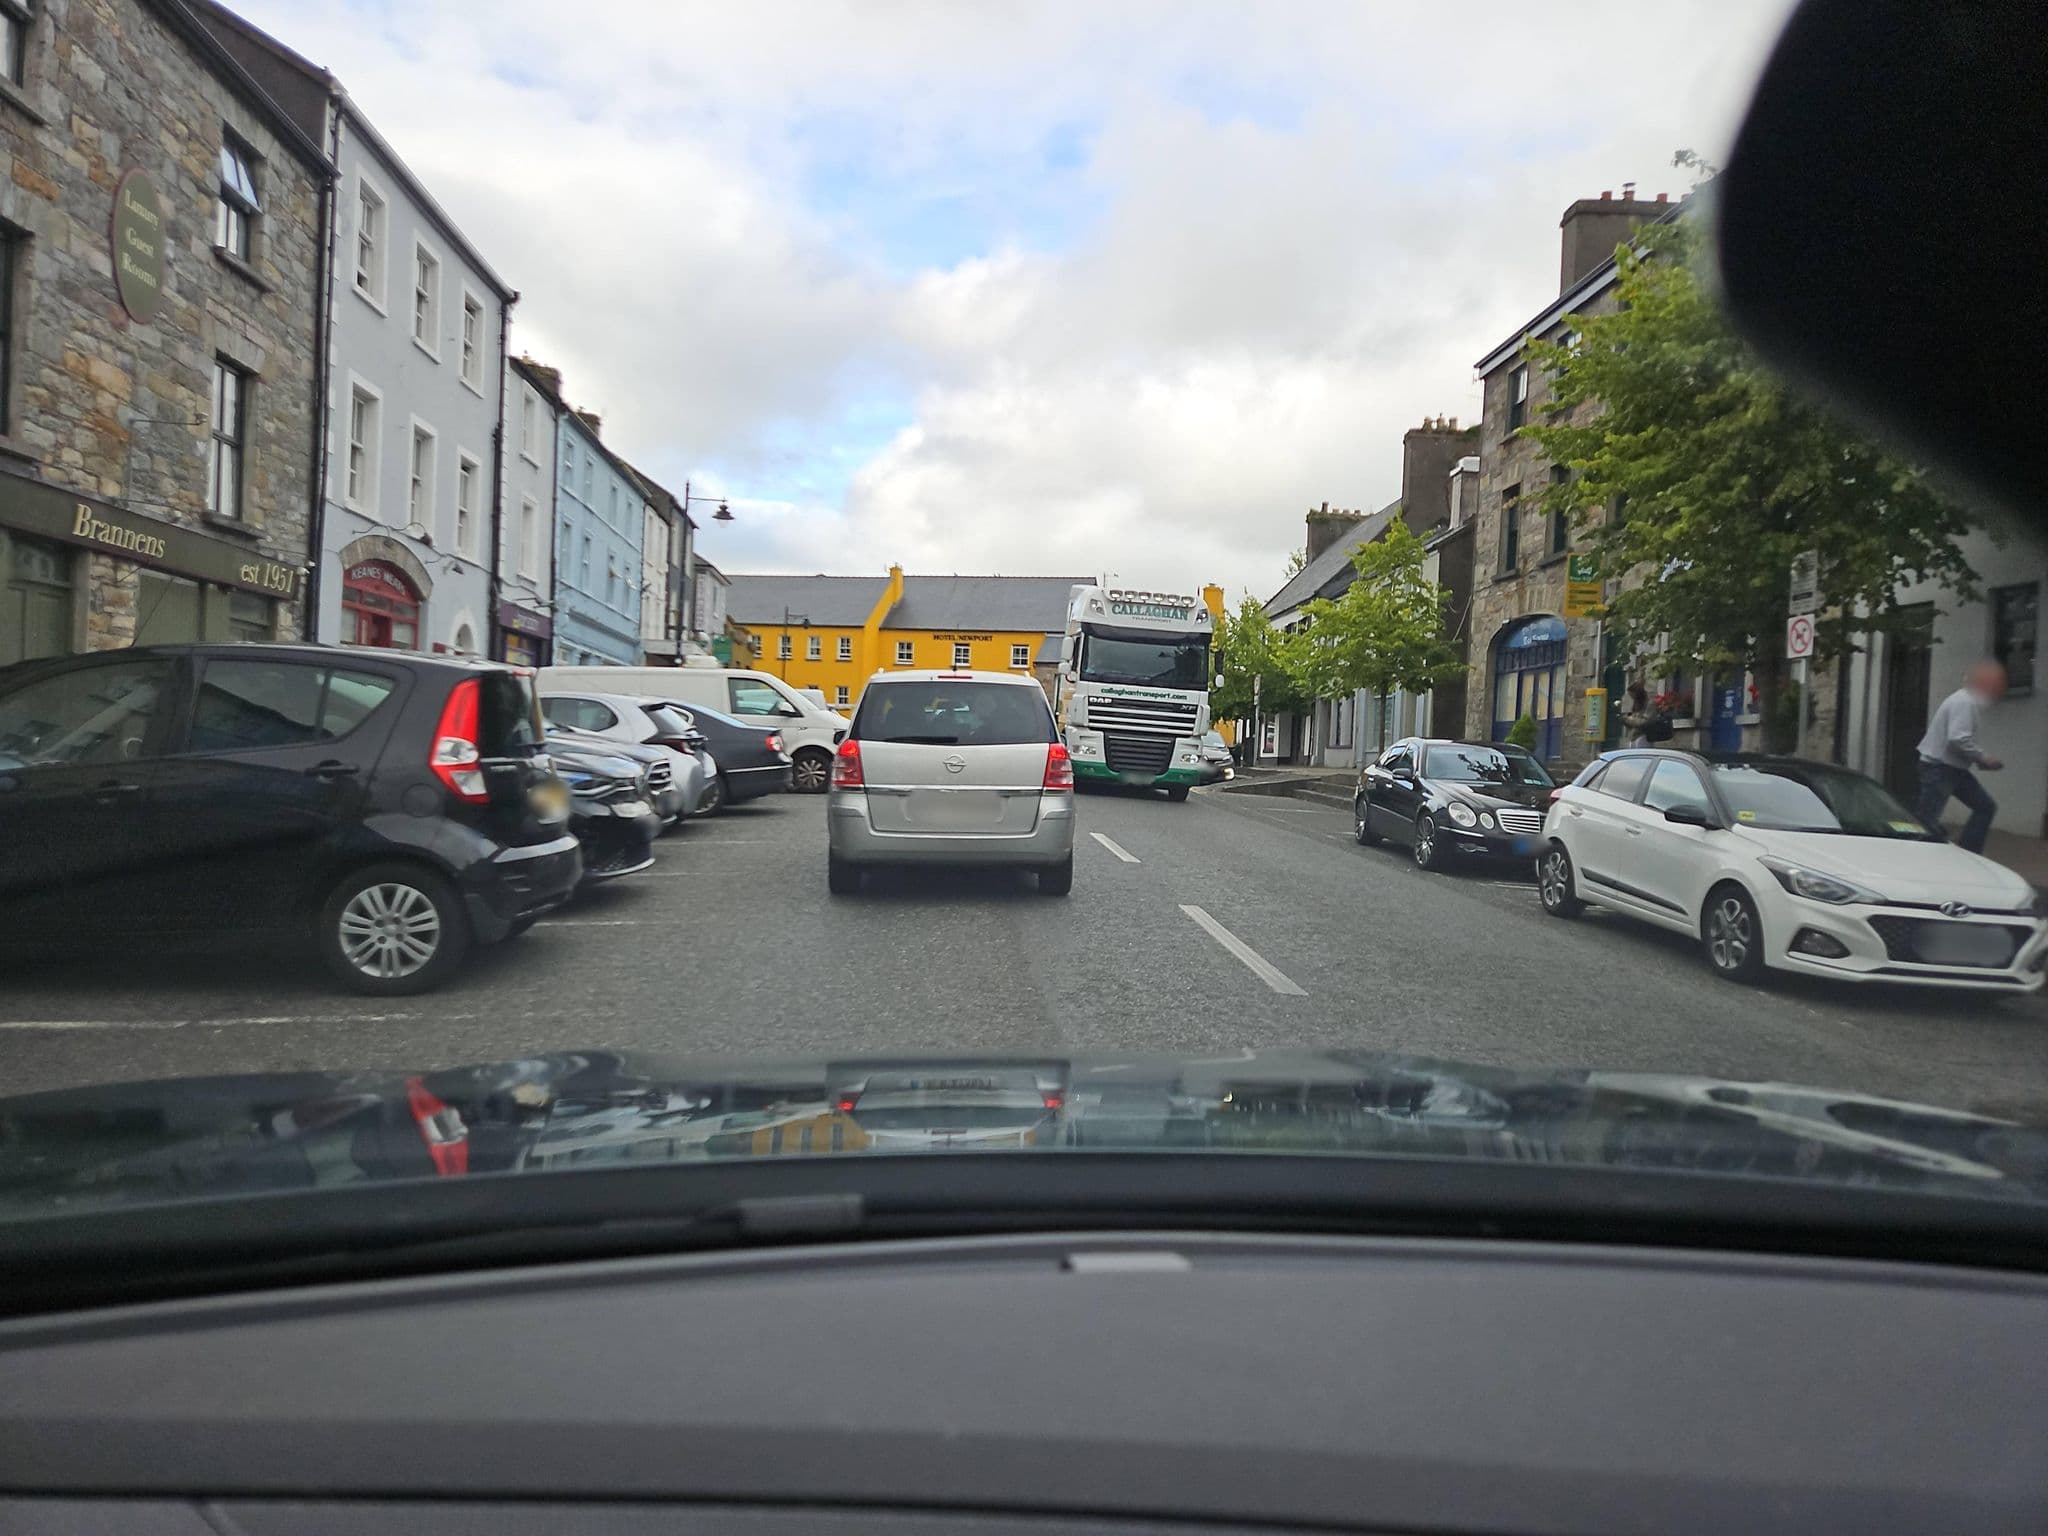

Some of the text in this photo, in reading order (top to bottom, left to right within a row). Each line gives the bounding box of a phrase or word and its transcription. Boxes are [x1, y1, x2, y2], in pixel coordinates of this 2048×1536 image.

[126, 227, 155, 258] Guest
[121, 251, 157, 289] Rooms
[72, 503, 294, 593] Brannens est 1951
[1112, 604, 1188, 620] CALLAGHAN
[1101, 688, 1187, 700] callaghantransport.com
